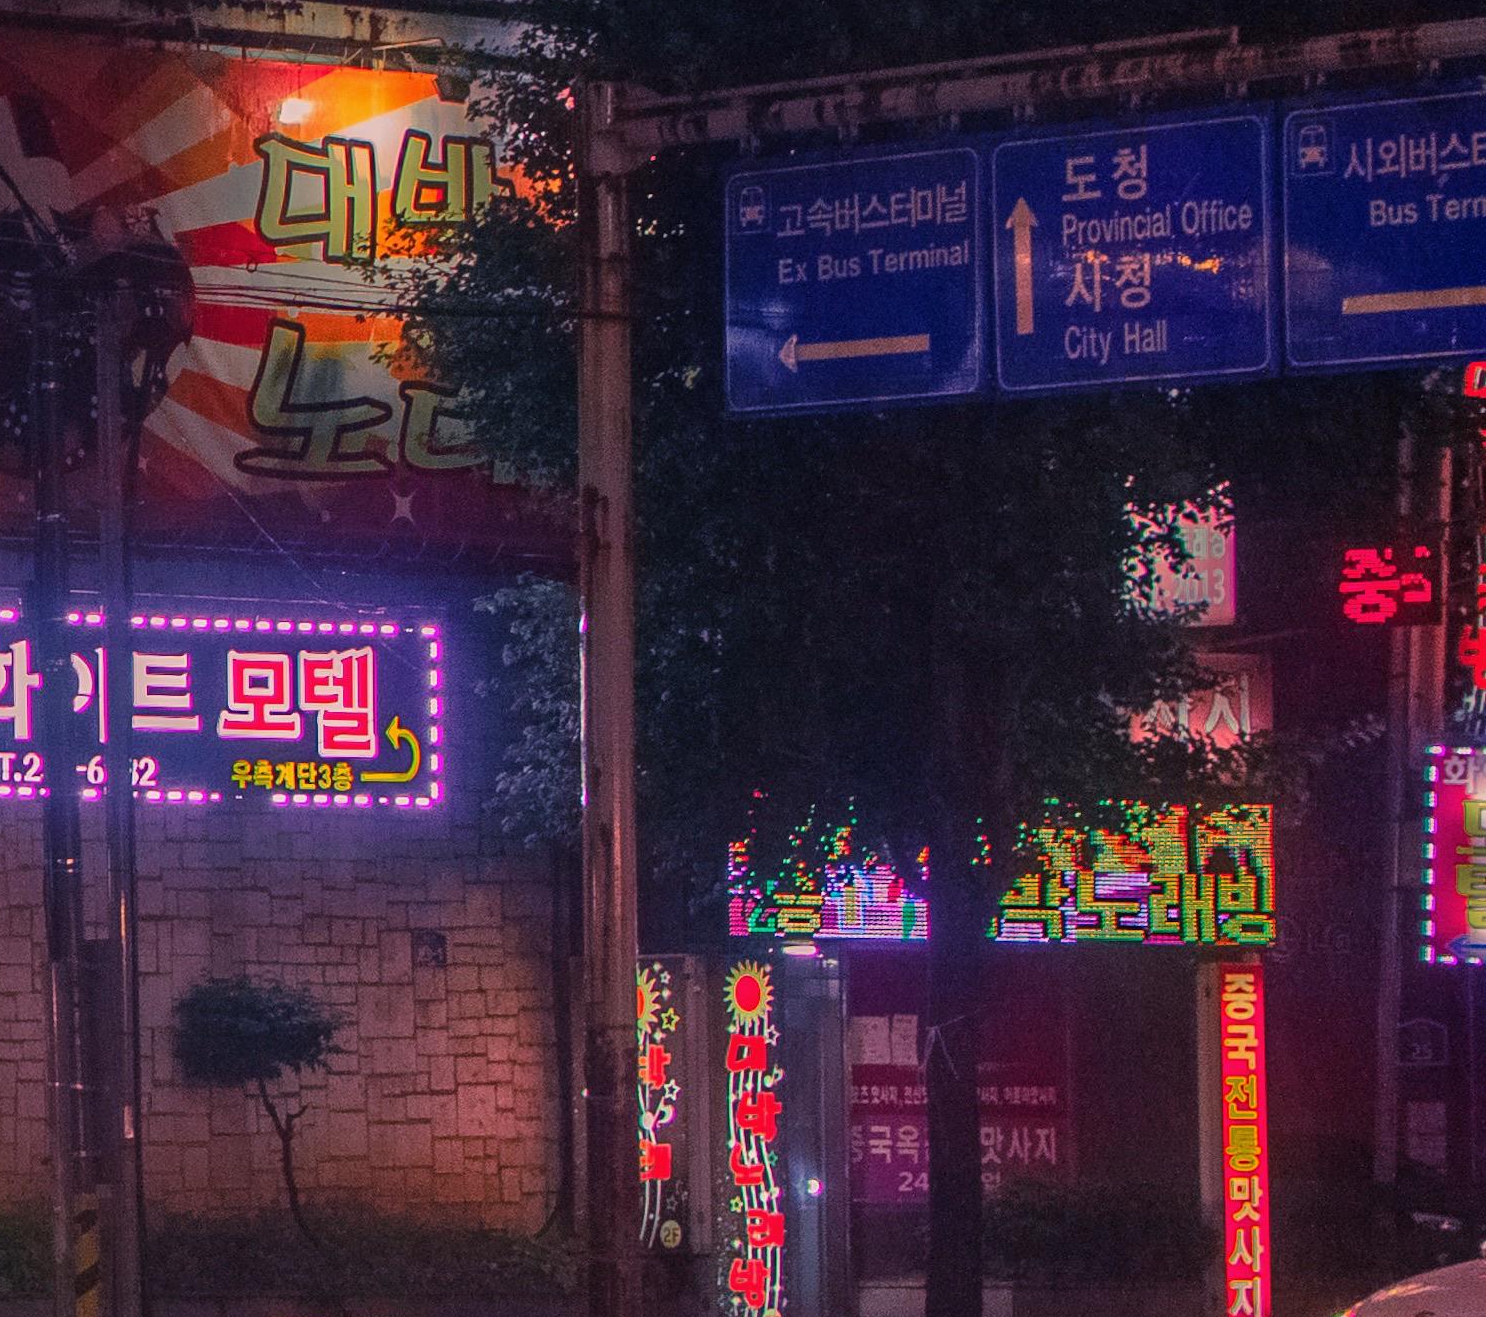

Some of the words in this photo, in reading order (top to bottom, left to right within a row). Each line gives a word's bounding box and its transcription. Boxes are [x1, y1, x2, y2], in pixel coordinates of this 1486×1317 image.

[1061, 144, 1148, 202] 도청
[777, 180, 967, 237] 고속버스터미널
[1062, 204, 1171, 246] Provincial
[1181, 198, 1253, 236] Office
[1369, 198, 1419, 226] Bus
[778, 258, 808, 284] Ex
[817, 254, 862, 282] Bus
[868, 240, 969, 275] Terminal
[1064, 252, 1153, 313] 시청
[1064, 323, 1113, 366] City
[1124, 319, 1168, 355] Hall
[217, 647, 379, 759] 모텔
[231, 759, 353, 791] 우측계단3층
